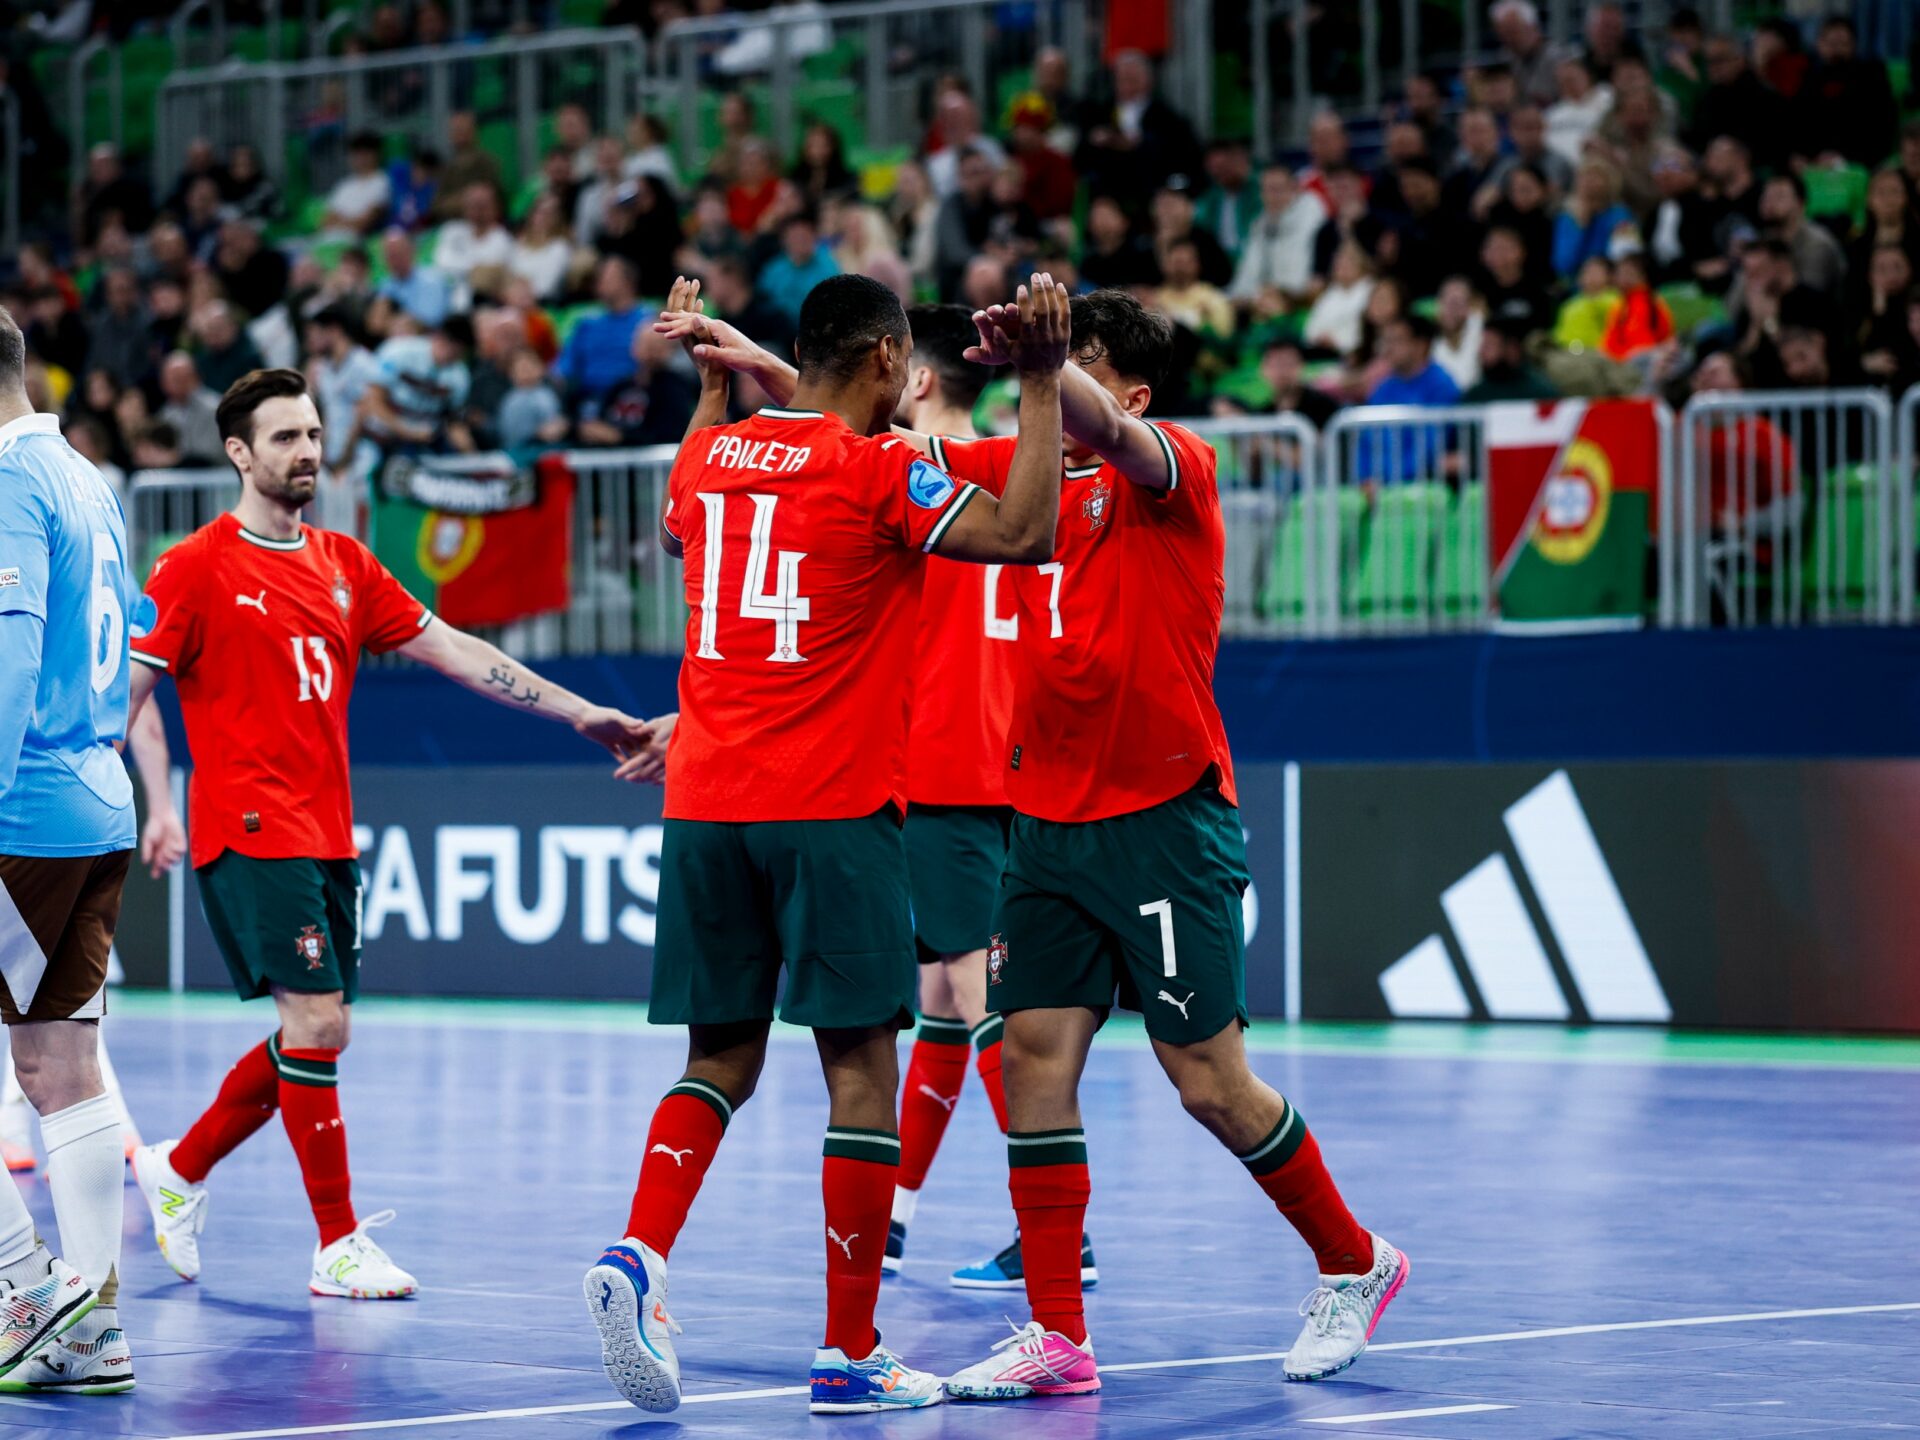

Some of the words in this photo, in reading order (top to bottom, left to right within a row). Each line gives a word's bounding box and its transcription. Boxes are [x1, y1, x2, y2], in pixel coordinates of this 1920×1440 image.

[706, 435, 812, 473] PAULETA
[0, 573, 19, 582] ION
[91, 531, 124, 695] 6
[696, 492, 810, 662] 14
[1037, 561, 1064, 639] 7
[290, 636, 333, 702] 13
